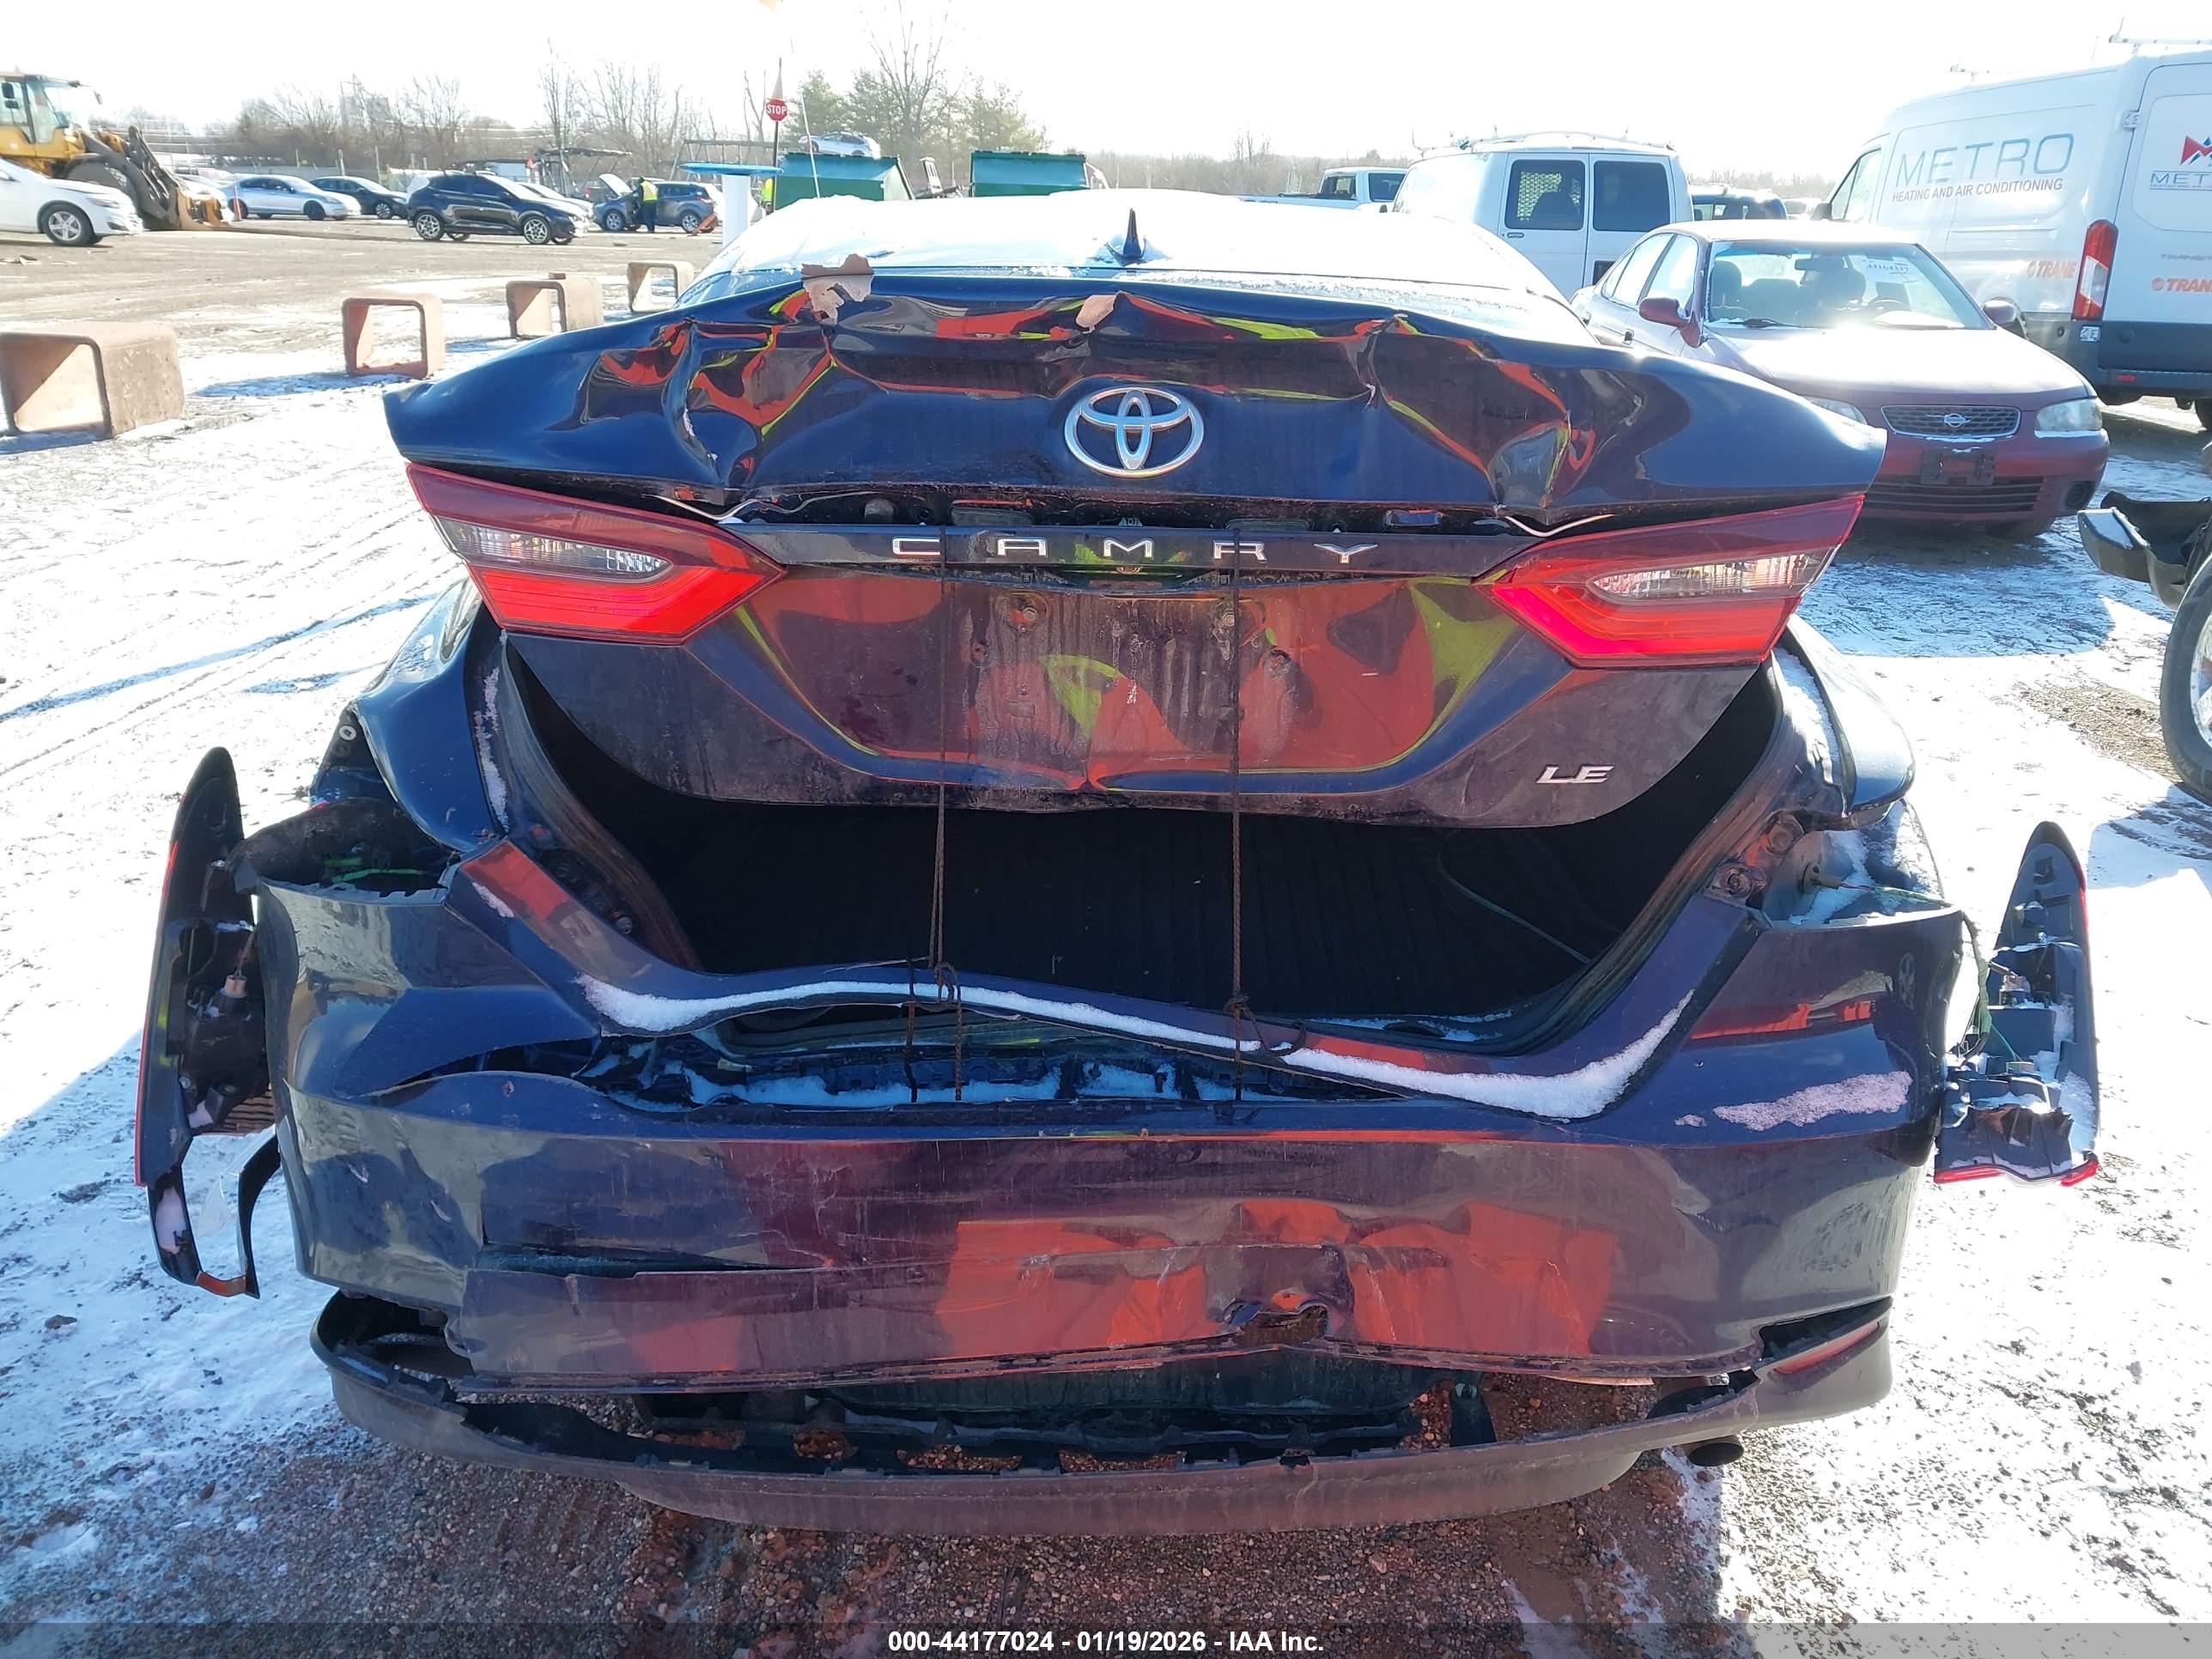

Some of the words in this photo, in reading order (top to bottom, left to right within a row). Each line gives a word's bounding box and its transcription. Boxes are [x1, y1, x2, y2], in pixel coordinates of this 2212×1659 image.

[767, 104, 787, 115] STOP
[1895, 133, 2075, 188] METRO
[1892, 186, 1930, 203] HEATING
[1931, 185, 1954, 198] AND
[1954, 183, 1974, 197] AIR
[1975, 177, 2063, 195] CONDITIONING
[891, 537, 1379, 565] CAMRY
[1535, 764, 1615, 784] LE
